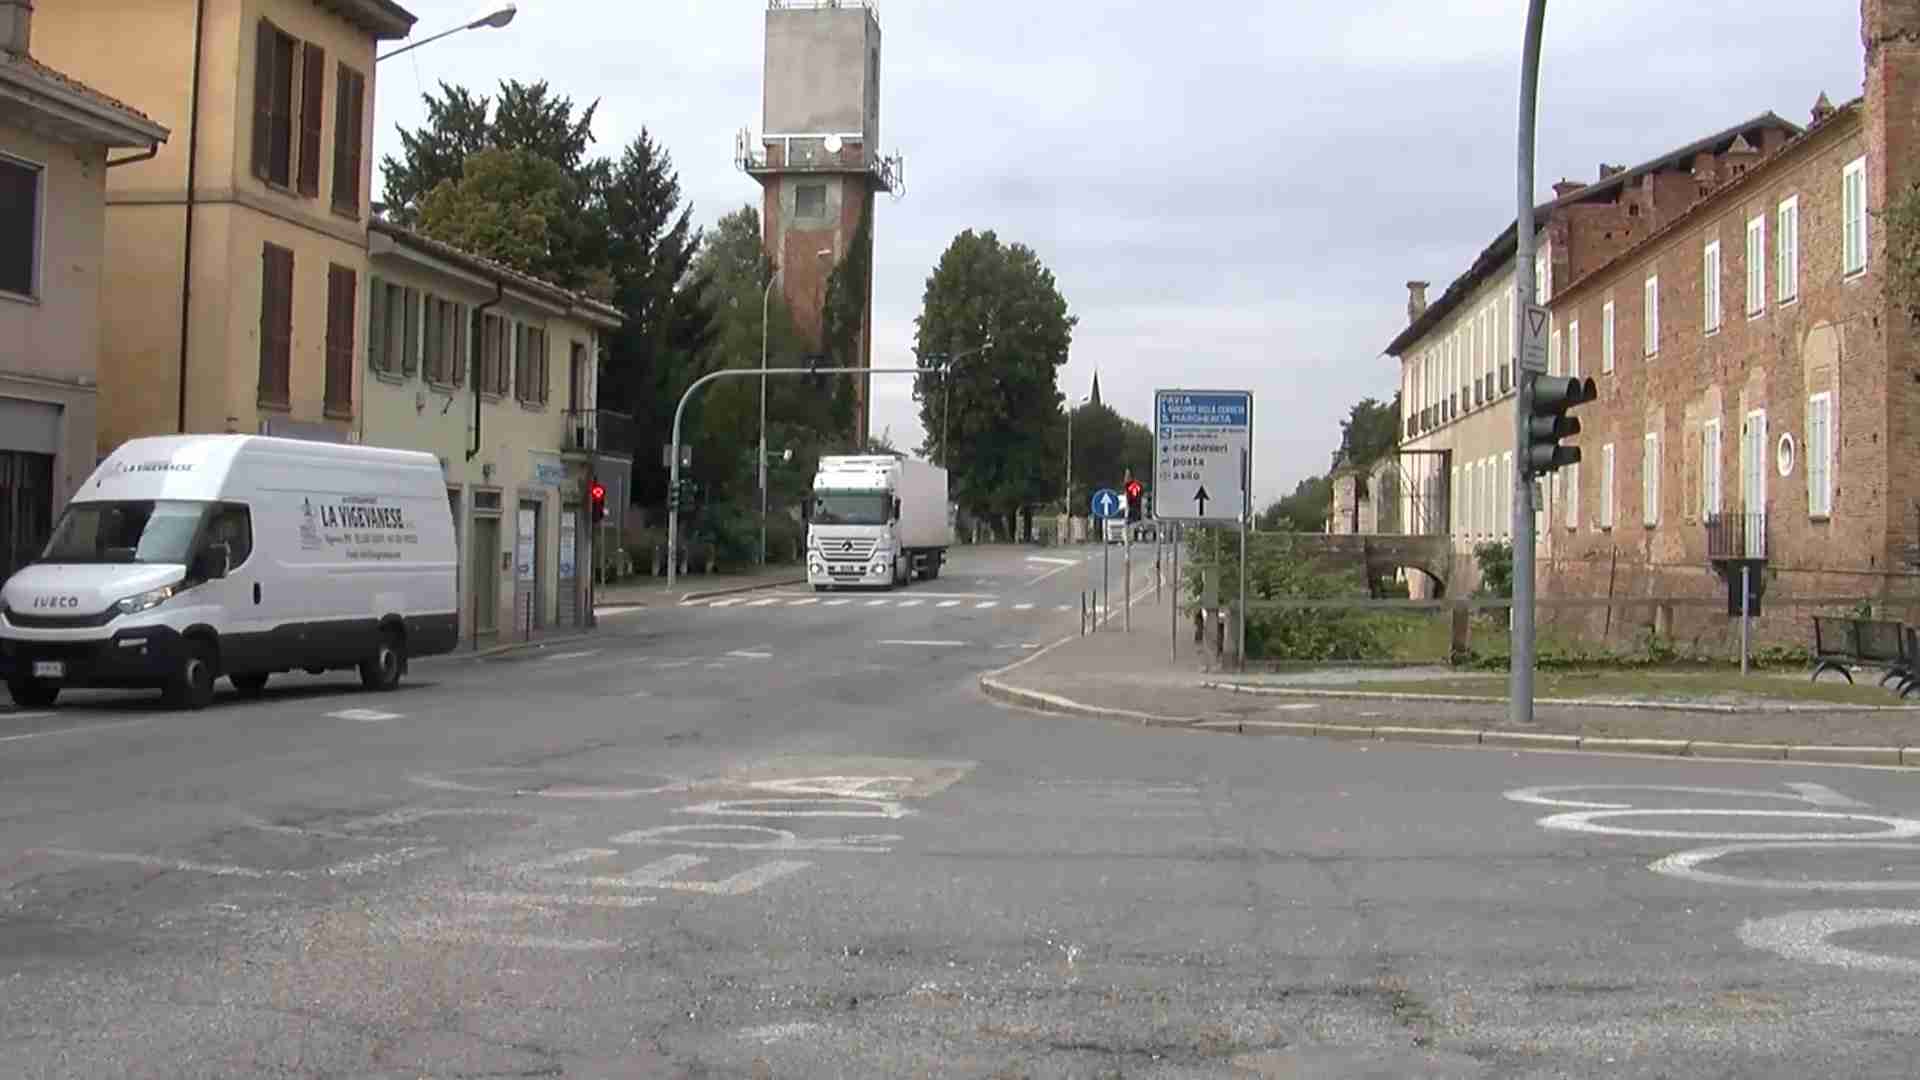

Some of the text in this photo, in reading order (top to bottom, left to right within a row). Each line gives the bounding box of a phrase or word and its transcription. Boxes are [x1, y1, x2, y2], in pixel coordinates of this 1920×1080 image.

[1173, 457, 1205, 467] posta
[1173, 471, 1200, 480] asilo
[320, 505, 404, 529] LA VIGEVANESE
[33, 596, 79, 608] IVECO
